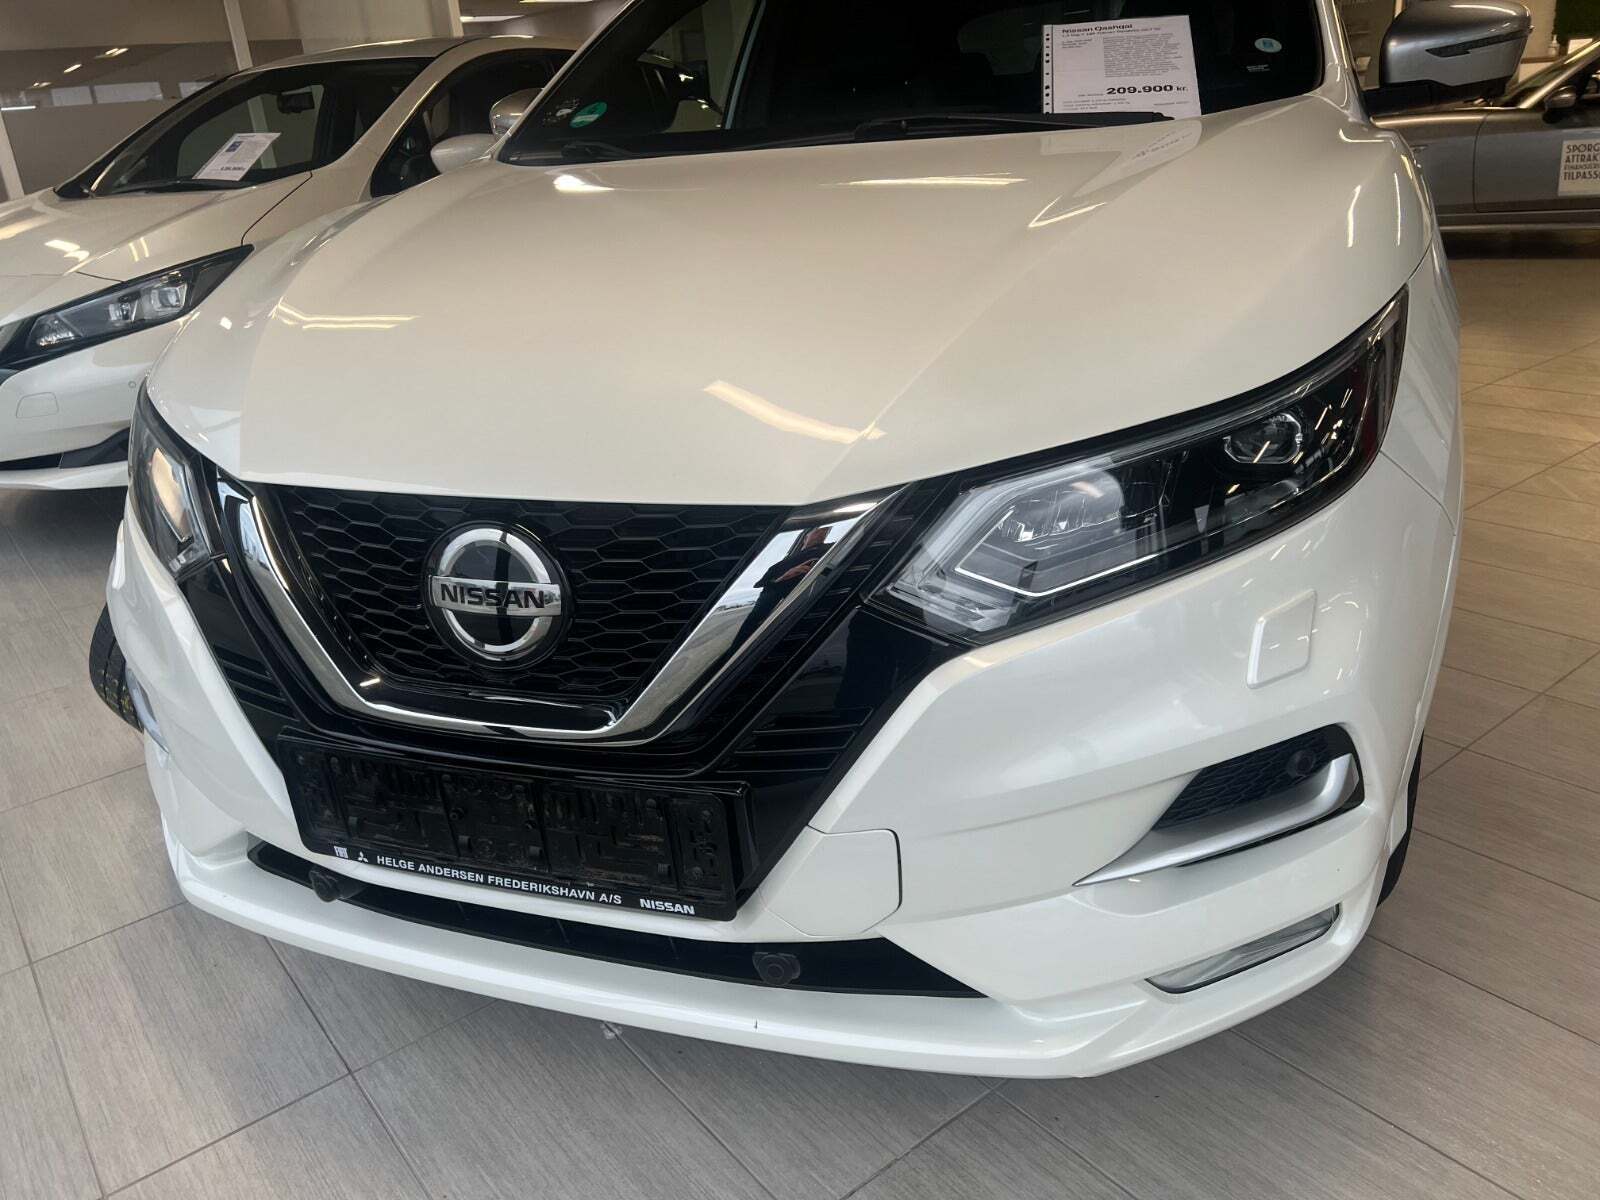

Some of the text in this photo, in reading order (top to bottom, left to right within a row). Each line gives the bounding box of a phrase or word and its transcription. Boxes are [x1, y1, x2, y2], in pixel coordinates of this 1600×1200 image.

[1106, 84, 1174, 95] 209.900
[1565, 153, 1600, 163] ATTRAK
[1564, 170, 1600, 180] TILPASS
[440, 583, 545, 608] NISSAN
[376, 855, 622, 905] HELGE ANDERSEN FREDERIKSHAVN A/S
[639, 898, 695, 915] NISSAN
